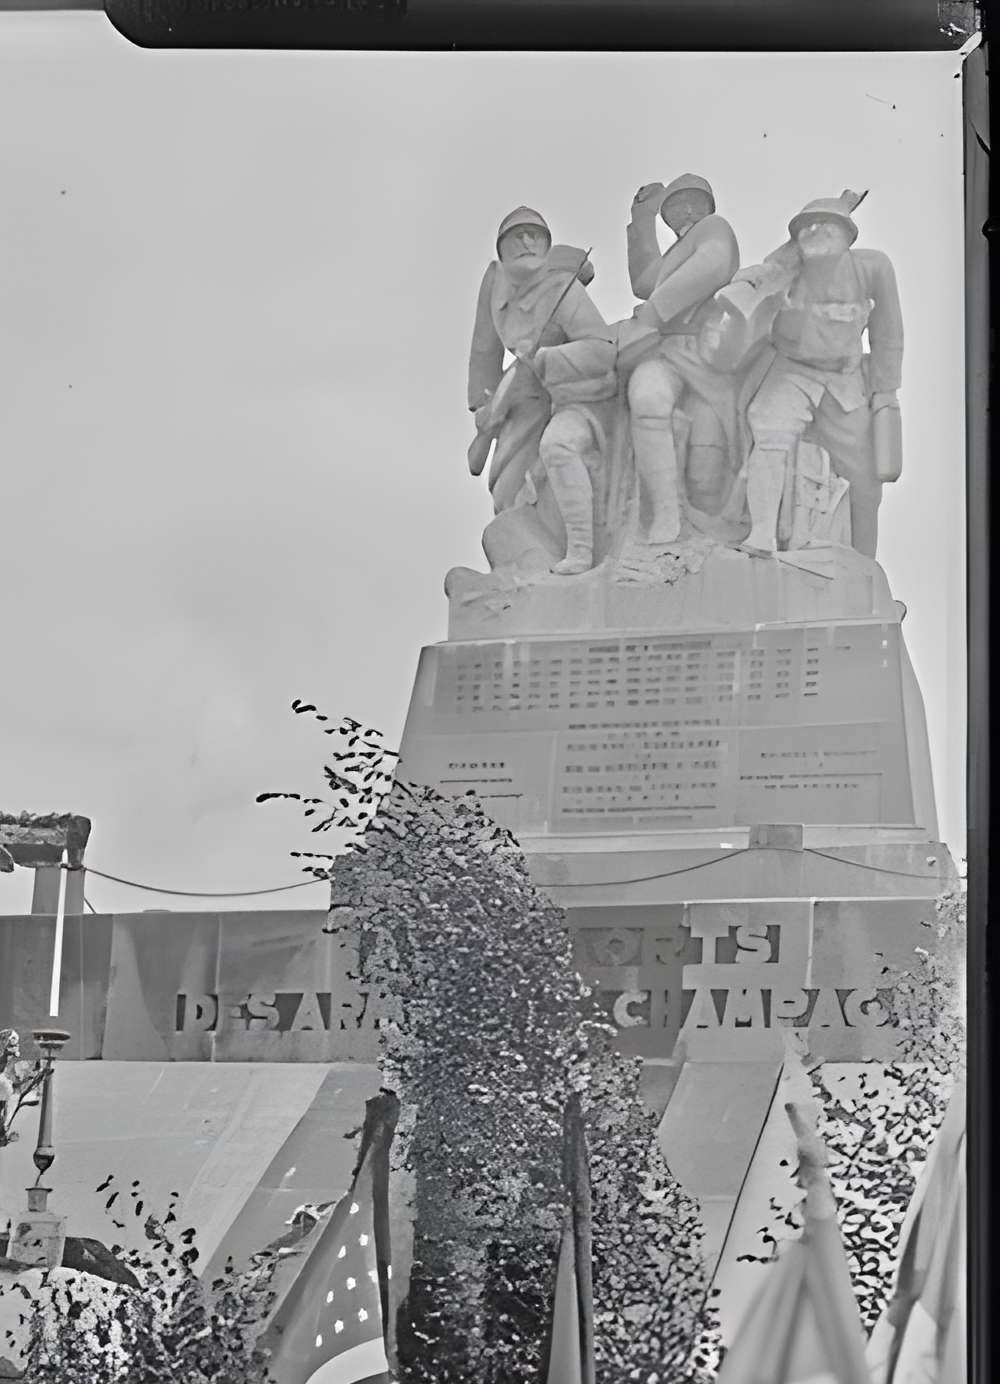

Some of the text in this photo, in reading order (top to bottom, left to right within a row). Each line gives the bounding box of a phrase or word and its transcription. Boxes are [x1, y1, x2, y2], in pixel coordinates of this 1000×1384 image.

[578, 925, 771, 964] ORTS
[184, 993, 280, 1031] DES
[612, 988, 900, 1028] CHAMPAG
